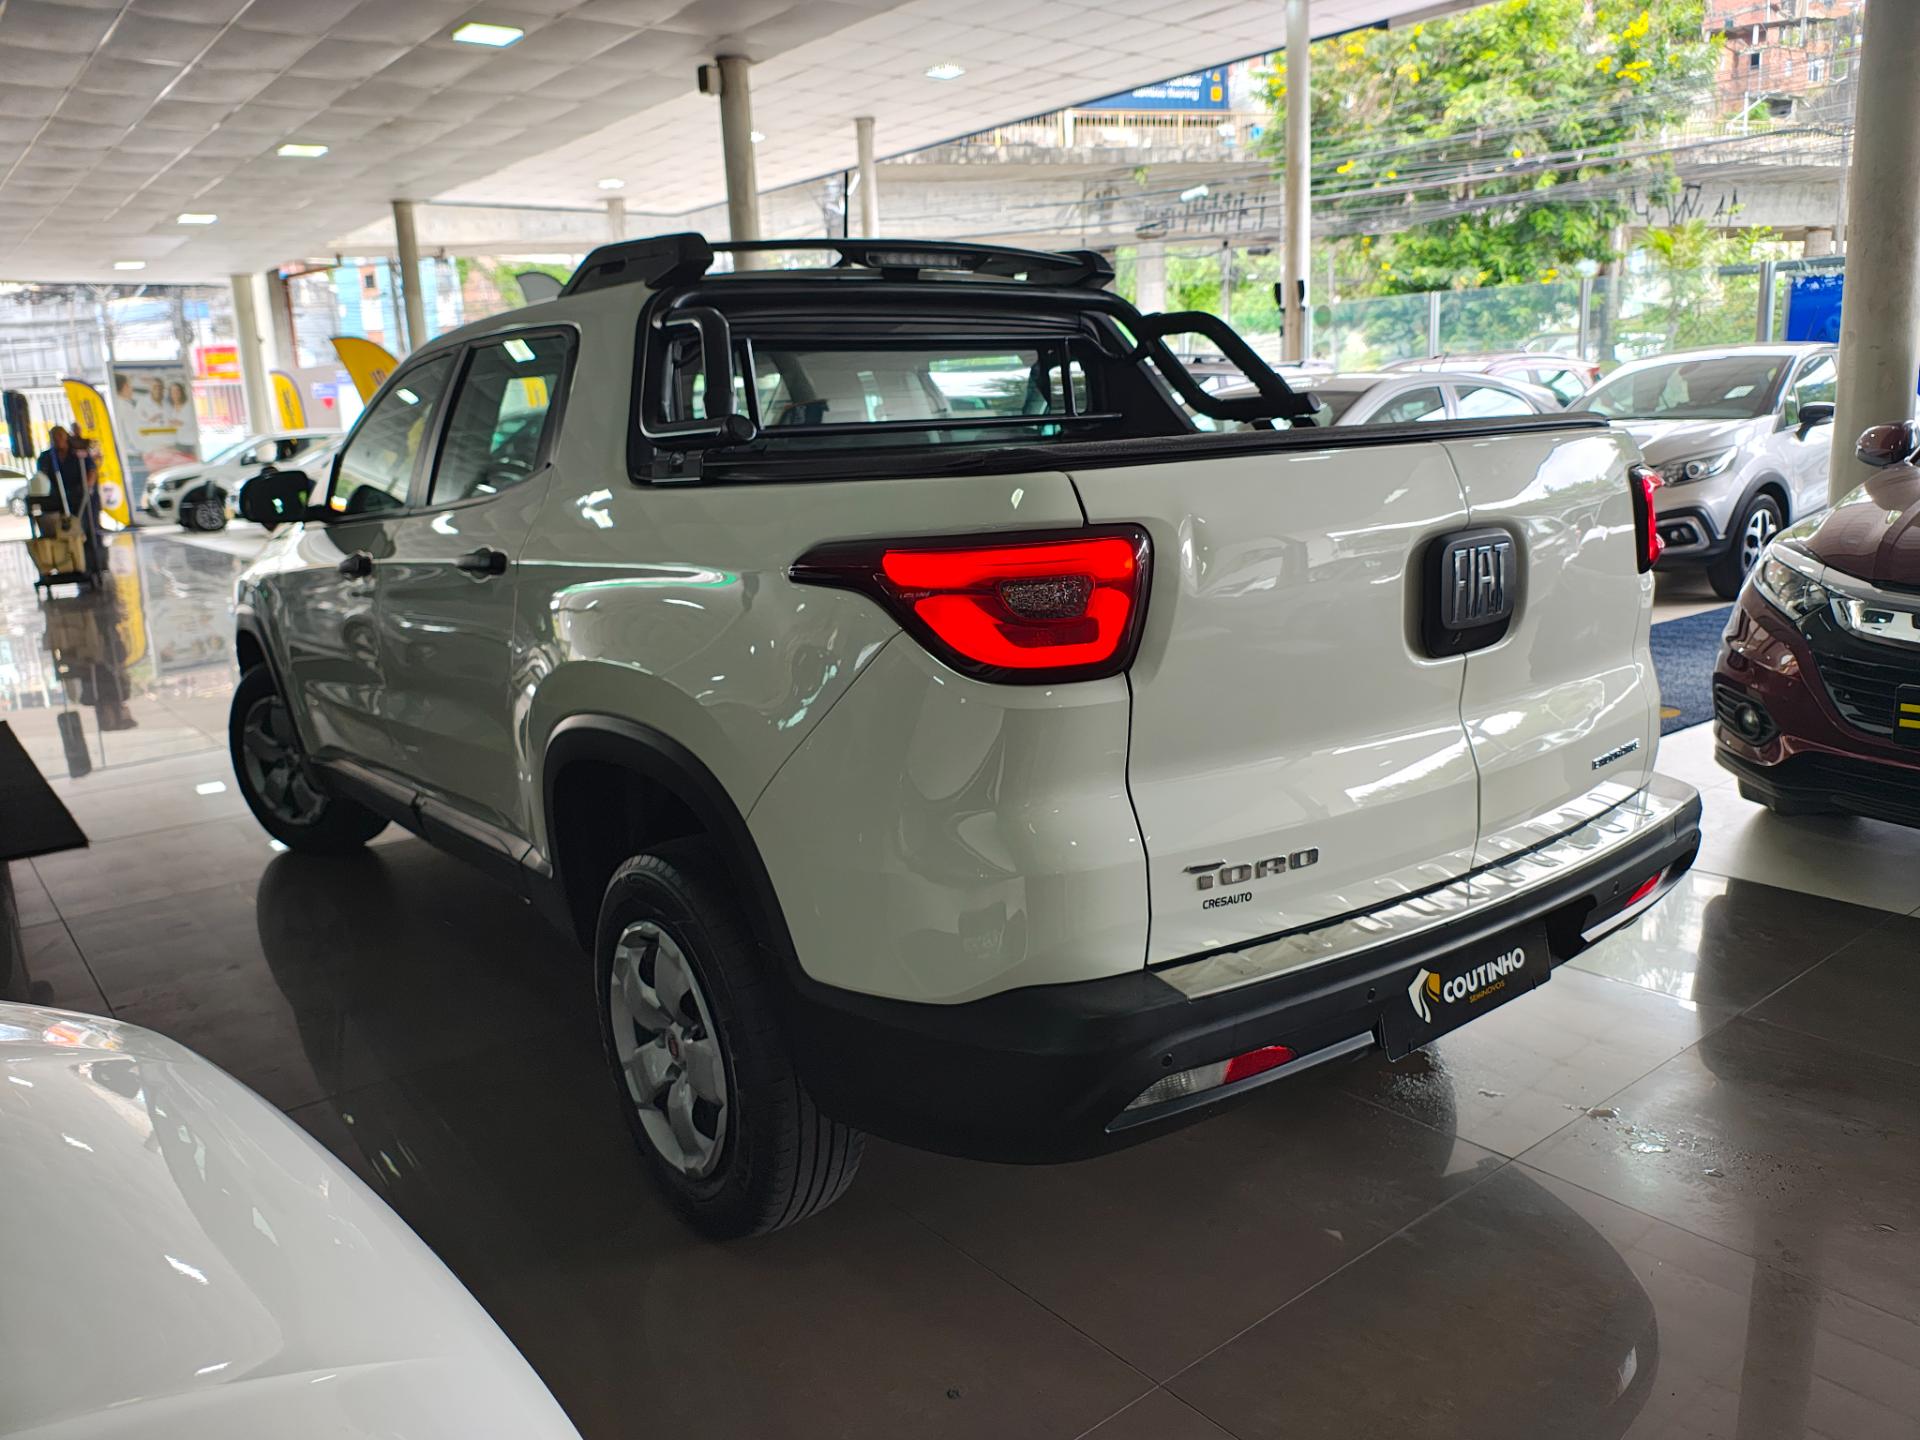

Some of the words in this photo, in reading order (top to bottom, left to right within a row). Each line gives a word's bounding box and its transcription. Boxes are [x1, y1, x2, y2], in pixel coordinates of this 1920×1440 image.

[1452, 542, 1510, 624] FIAT
[1182, 847, 1319, 890] TORO
[1202, 891, 1253, 910] CRESAUTO
[1443, 947, 1525, 1003] COUTINHO
